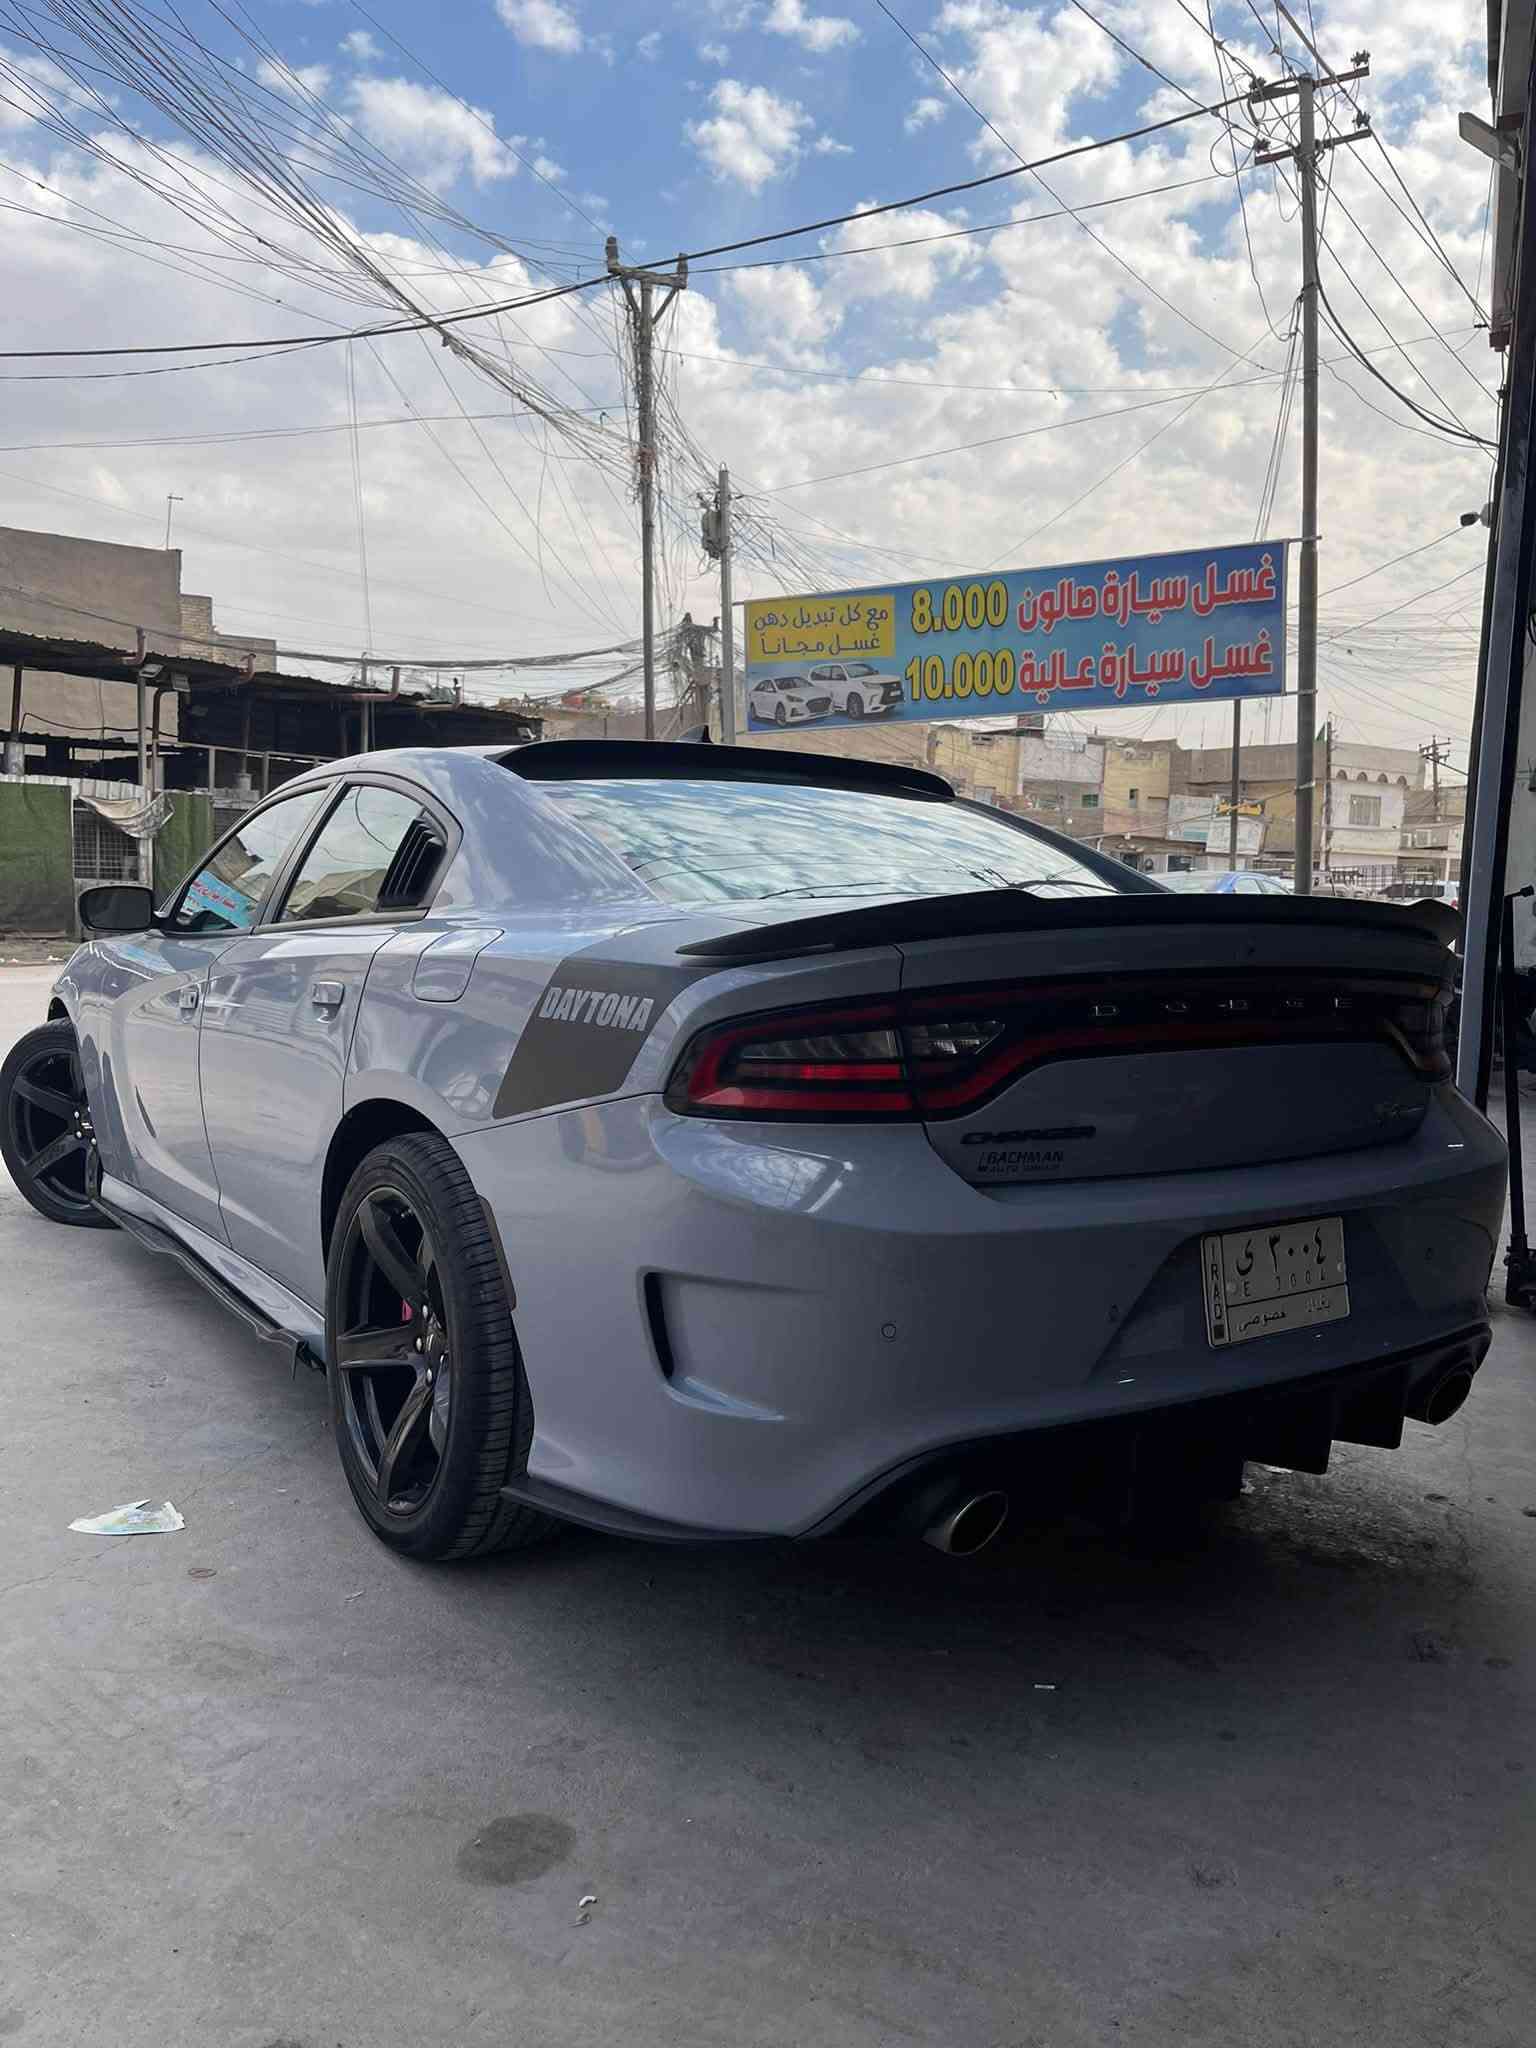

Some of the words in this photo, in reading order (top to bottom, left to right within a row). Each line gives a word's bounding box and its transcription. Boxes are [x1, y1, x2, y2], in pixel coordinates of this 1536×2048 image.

[912, 580, 1008, 634] 8.000
[1017, 577, 1098, 634] صالون
[1101, 570, 1189, 627] سيارة
[1192, 553, 1276, 616] غسل
[754, 611, 788, 631] دهن
[793, 607, 836, 629] تبديل
[839, 601, 861, 626] كل
[866, 607, 888, 632] مع
[829, 632, 880, 655] غسل
[1099, 641, 1186, 698] سيارة
[1188, 627, 1273, 689] غسل
[905, 648, 1015, 701] 10.000
[1018, 649, 1096, 704] عالية
[538, 987, 655, 1032] DAYTONA
[985, 1151, 1063, 1164] BACHMAN
